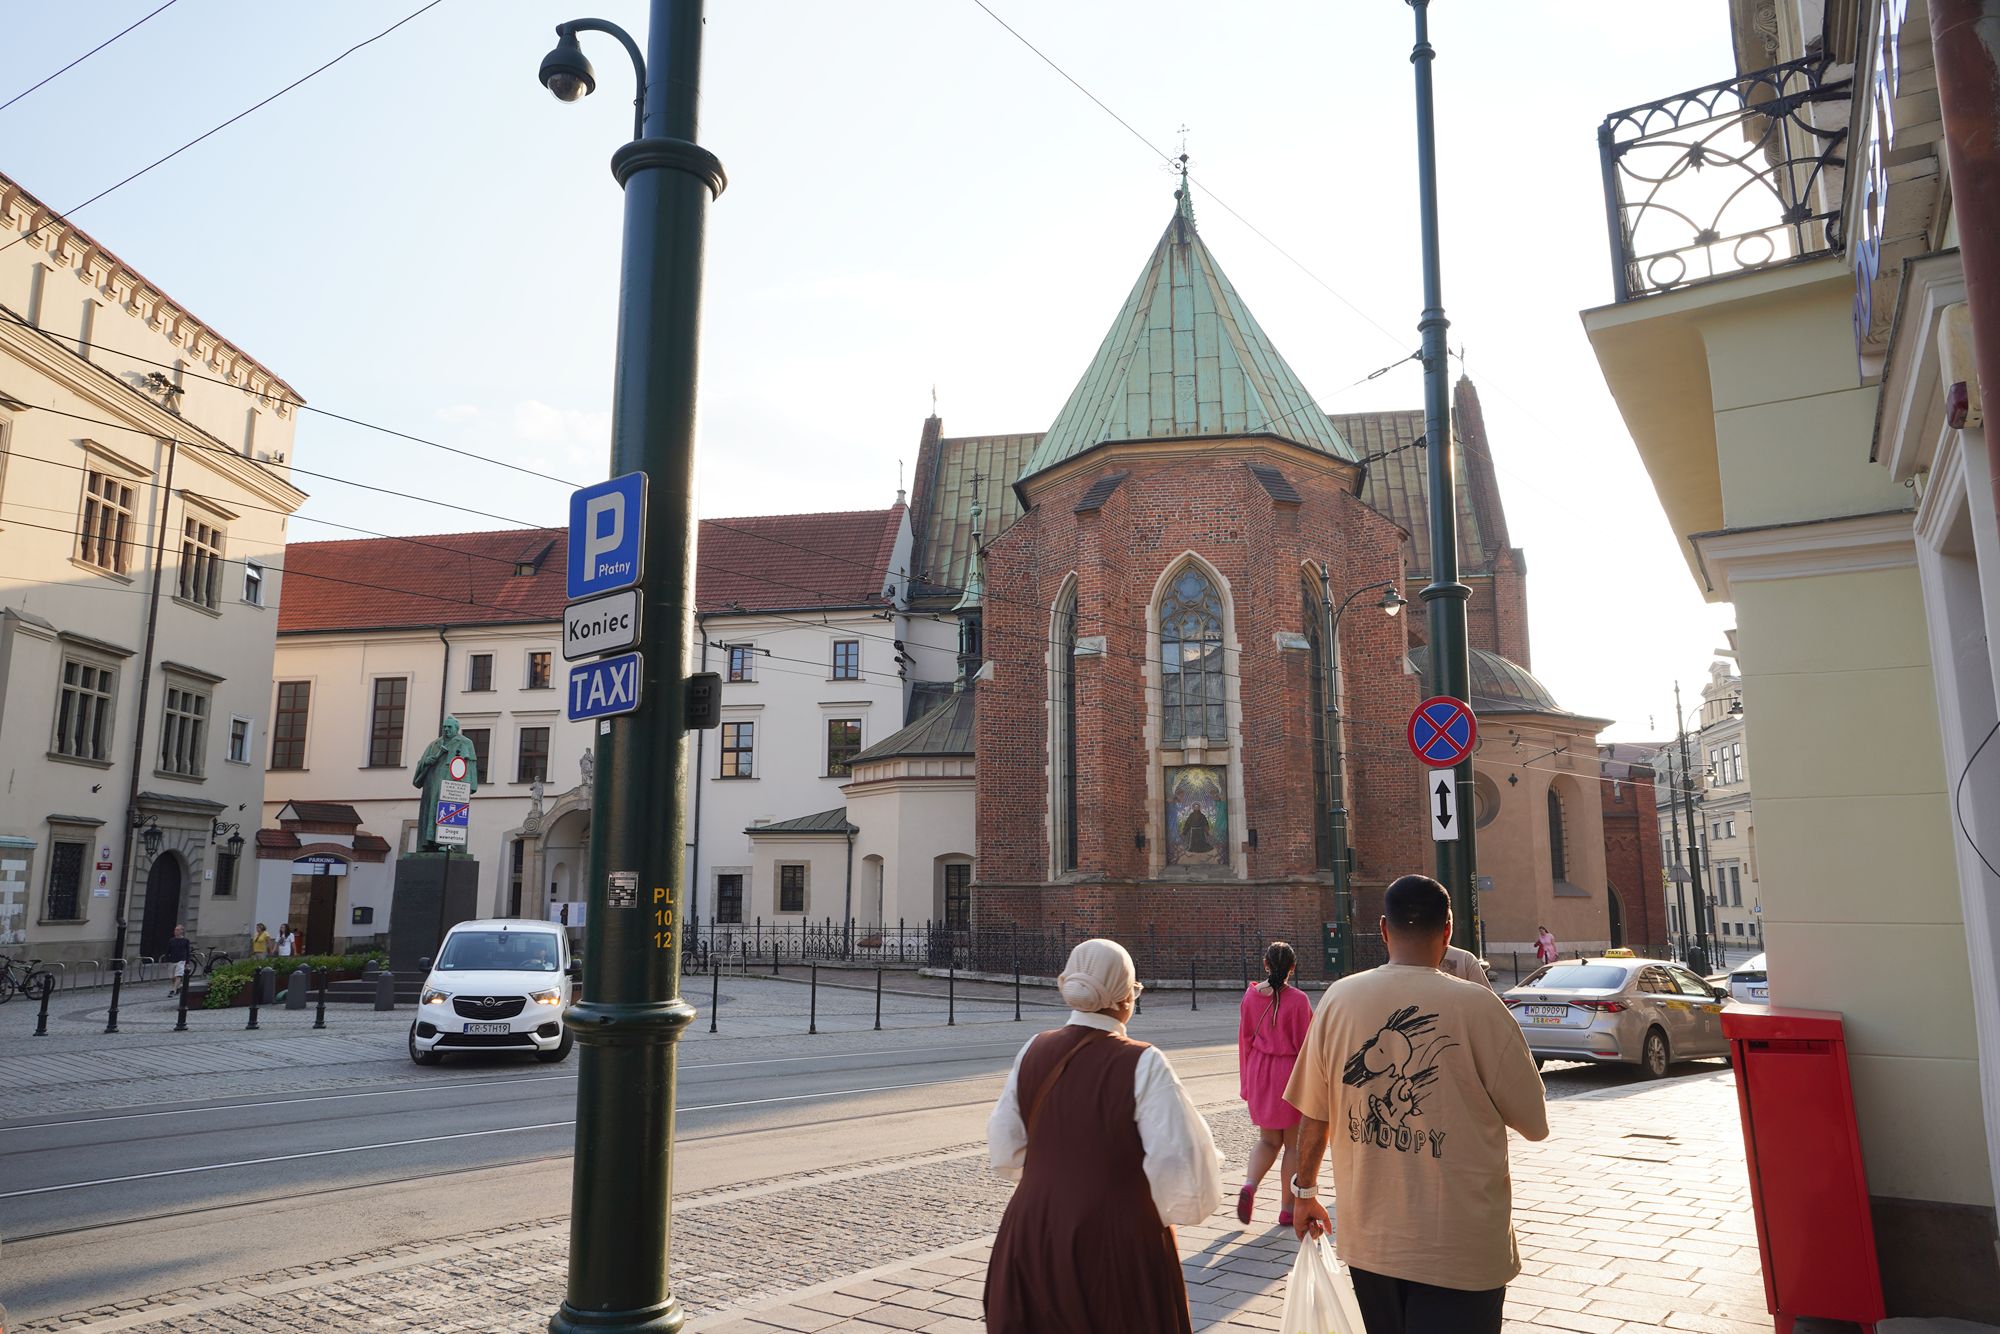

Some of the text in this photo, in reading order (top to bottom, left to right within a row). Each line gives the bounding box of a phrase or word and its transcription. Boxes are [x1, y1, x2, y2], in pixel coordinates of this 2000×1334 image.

[583, 491, 626, 582] P
[598, 560, 631, 577] Płatny
[569, 612, 629, 642] Koniec
[571, 661, 635, 712] TAXI
[653, 887, 674, 904] PL
[655, 909, 673, 926] 10
[654, 931, 672, 948] 12
[469, 1024, 481, 1033] KR
[1349, 1117, 1446, 1158] SNOOPY
